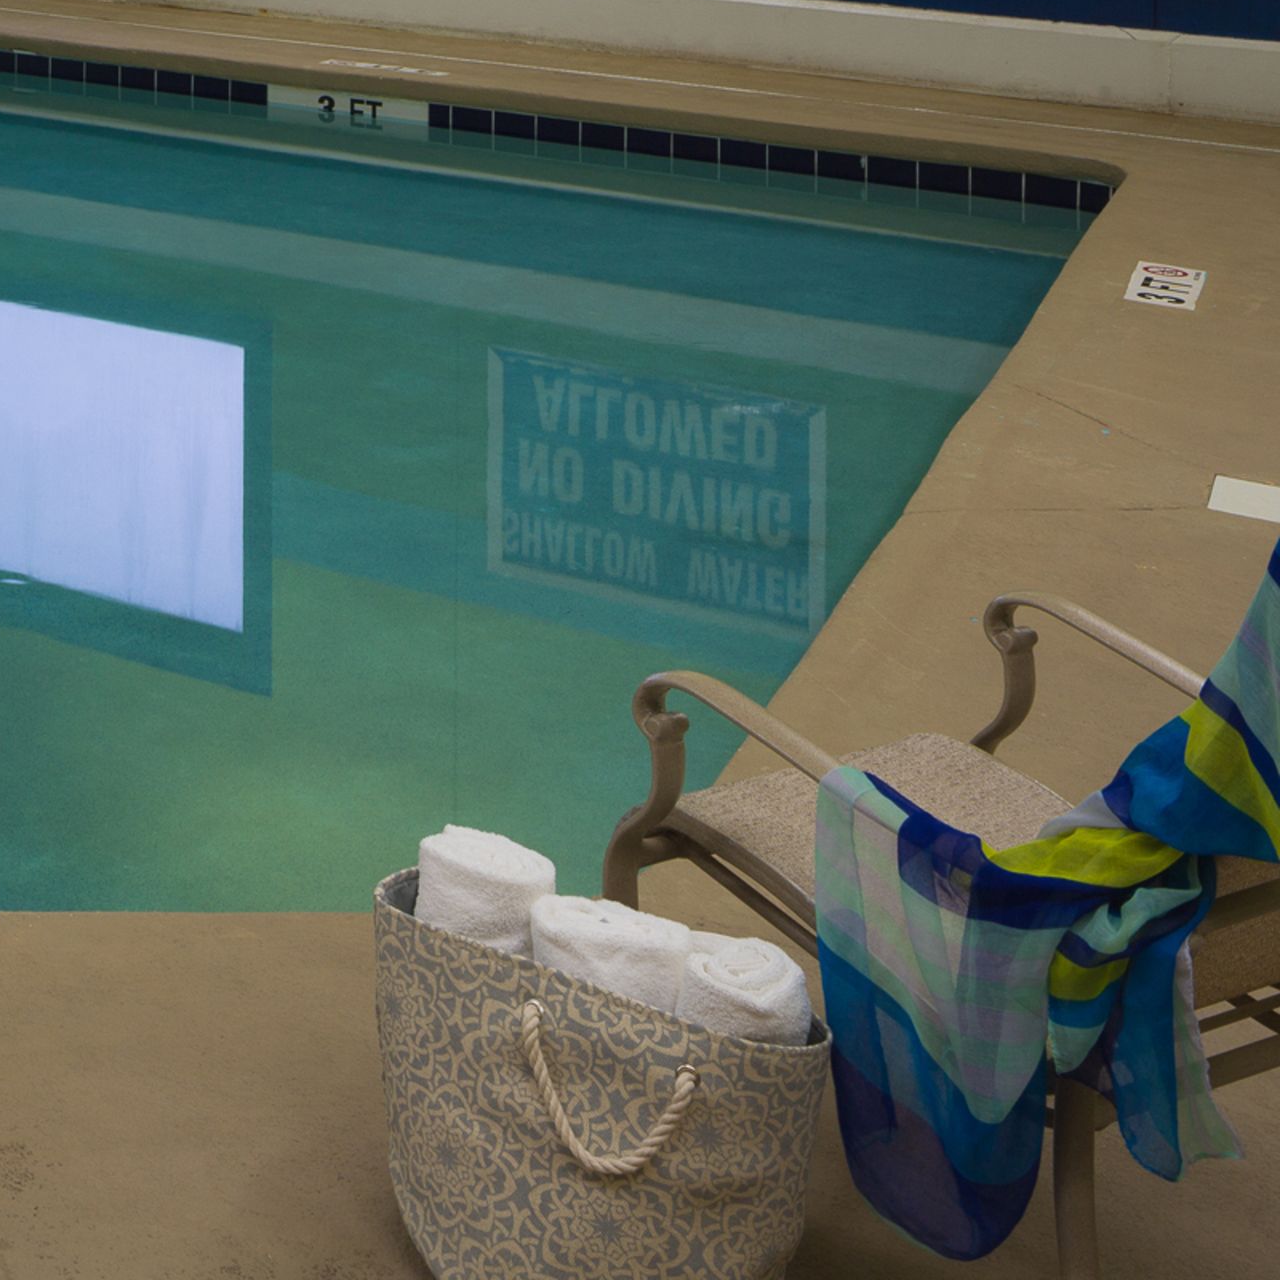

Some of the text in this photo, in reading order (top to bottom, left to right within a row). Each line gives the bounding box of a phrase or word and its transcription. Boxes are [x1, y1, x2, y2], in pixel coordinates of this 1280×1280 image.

[317, 95, 383, 120] 3 FT
[1136, 275, 1193, 305] 3 FT
